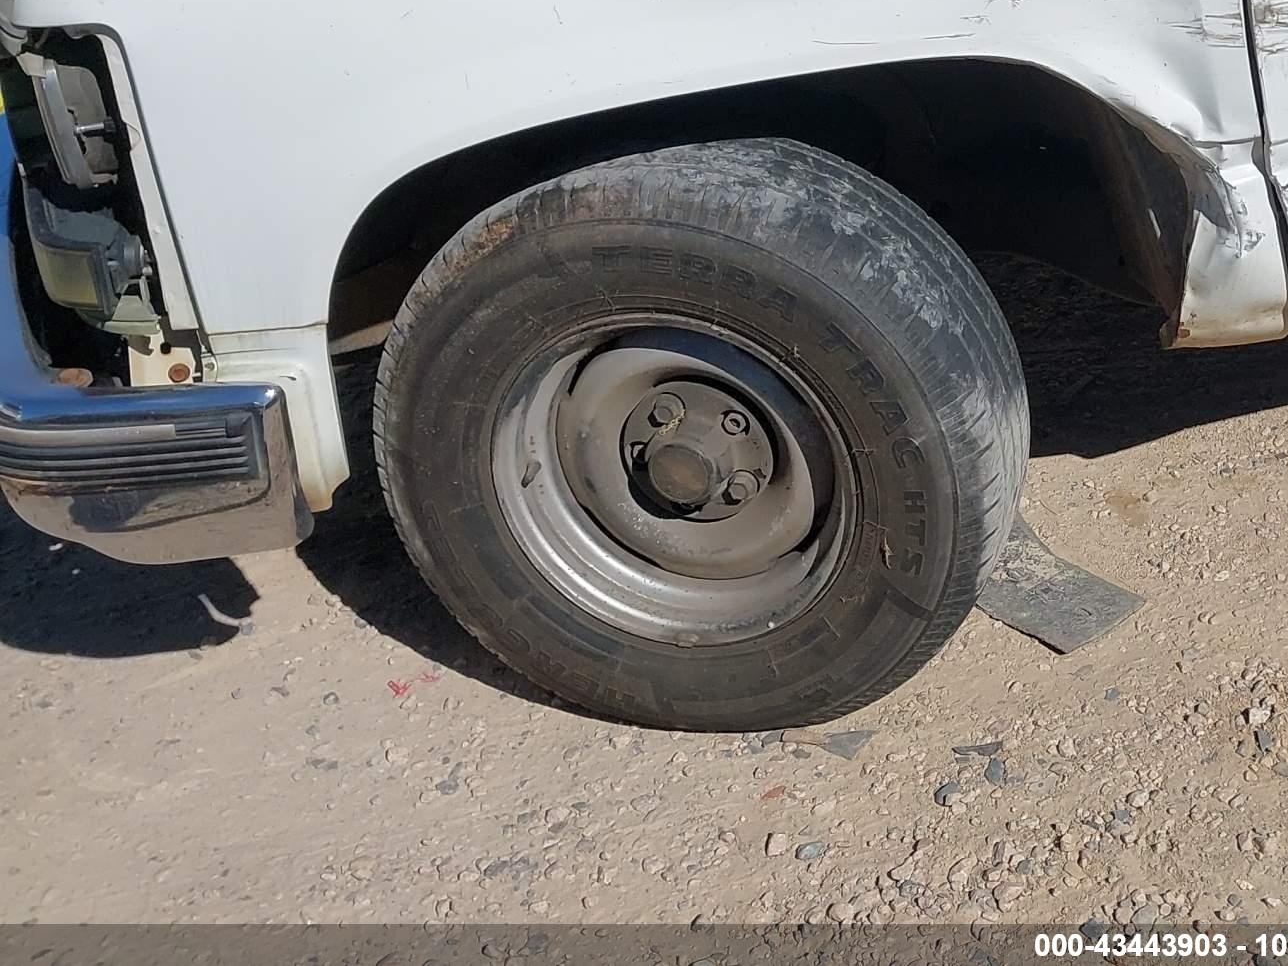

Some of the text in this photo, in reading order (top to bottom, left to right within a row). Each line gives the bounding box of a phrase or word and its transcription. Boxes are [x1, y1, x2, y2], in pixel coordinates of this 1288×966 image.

[591, 244, 928, 577] TERRA TRAC HTS
